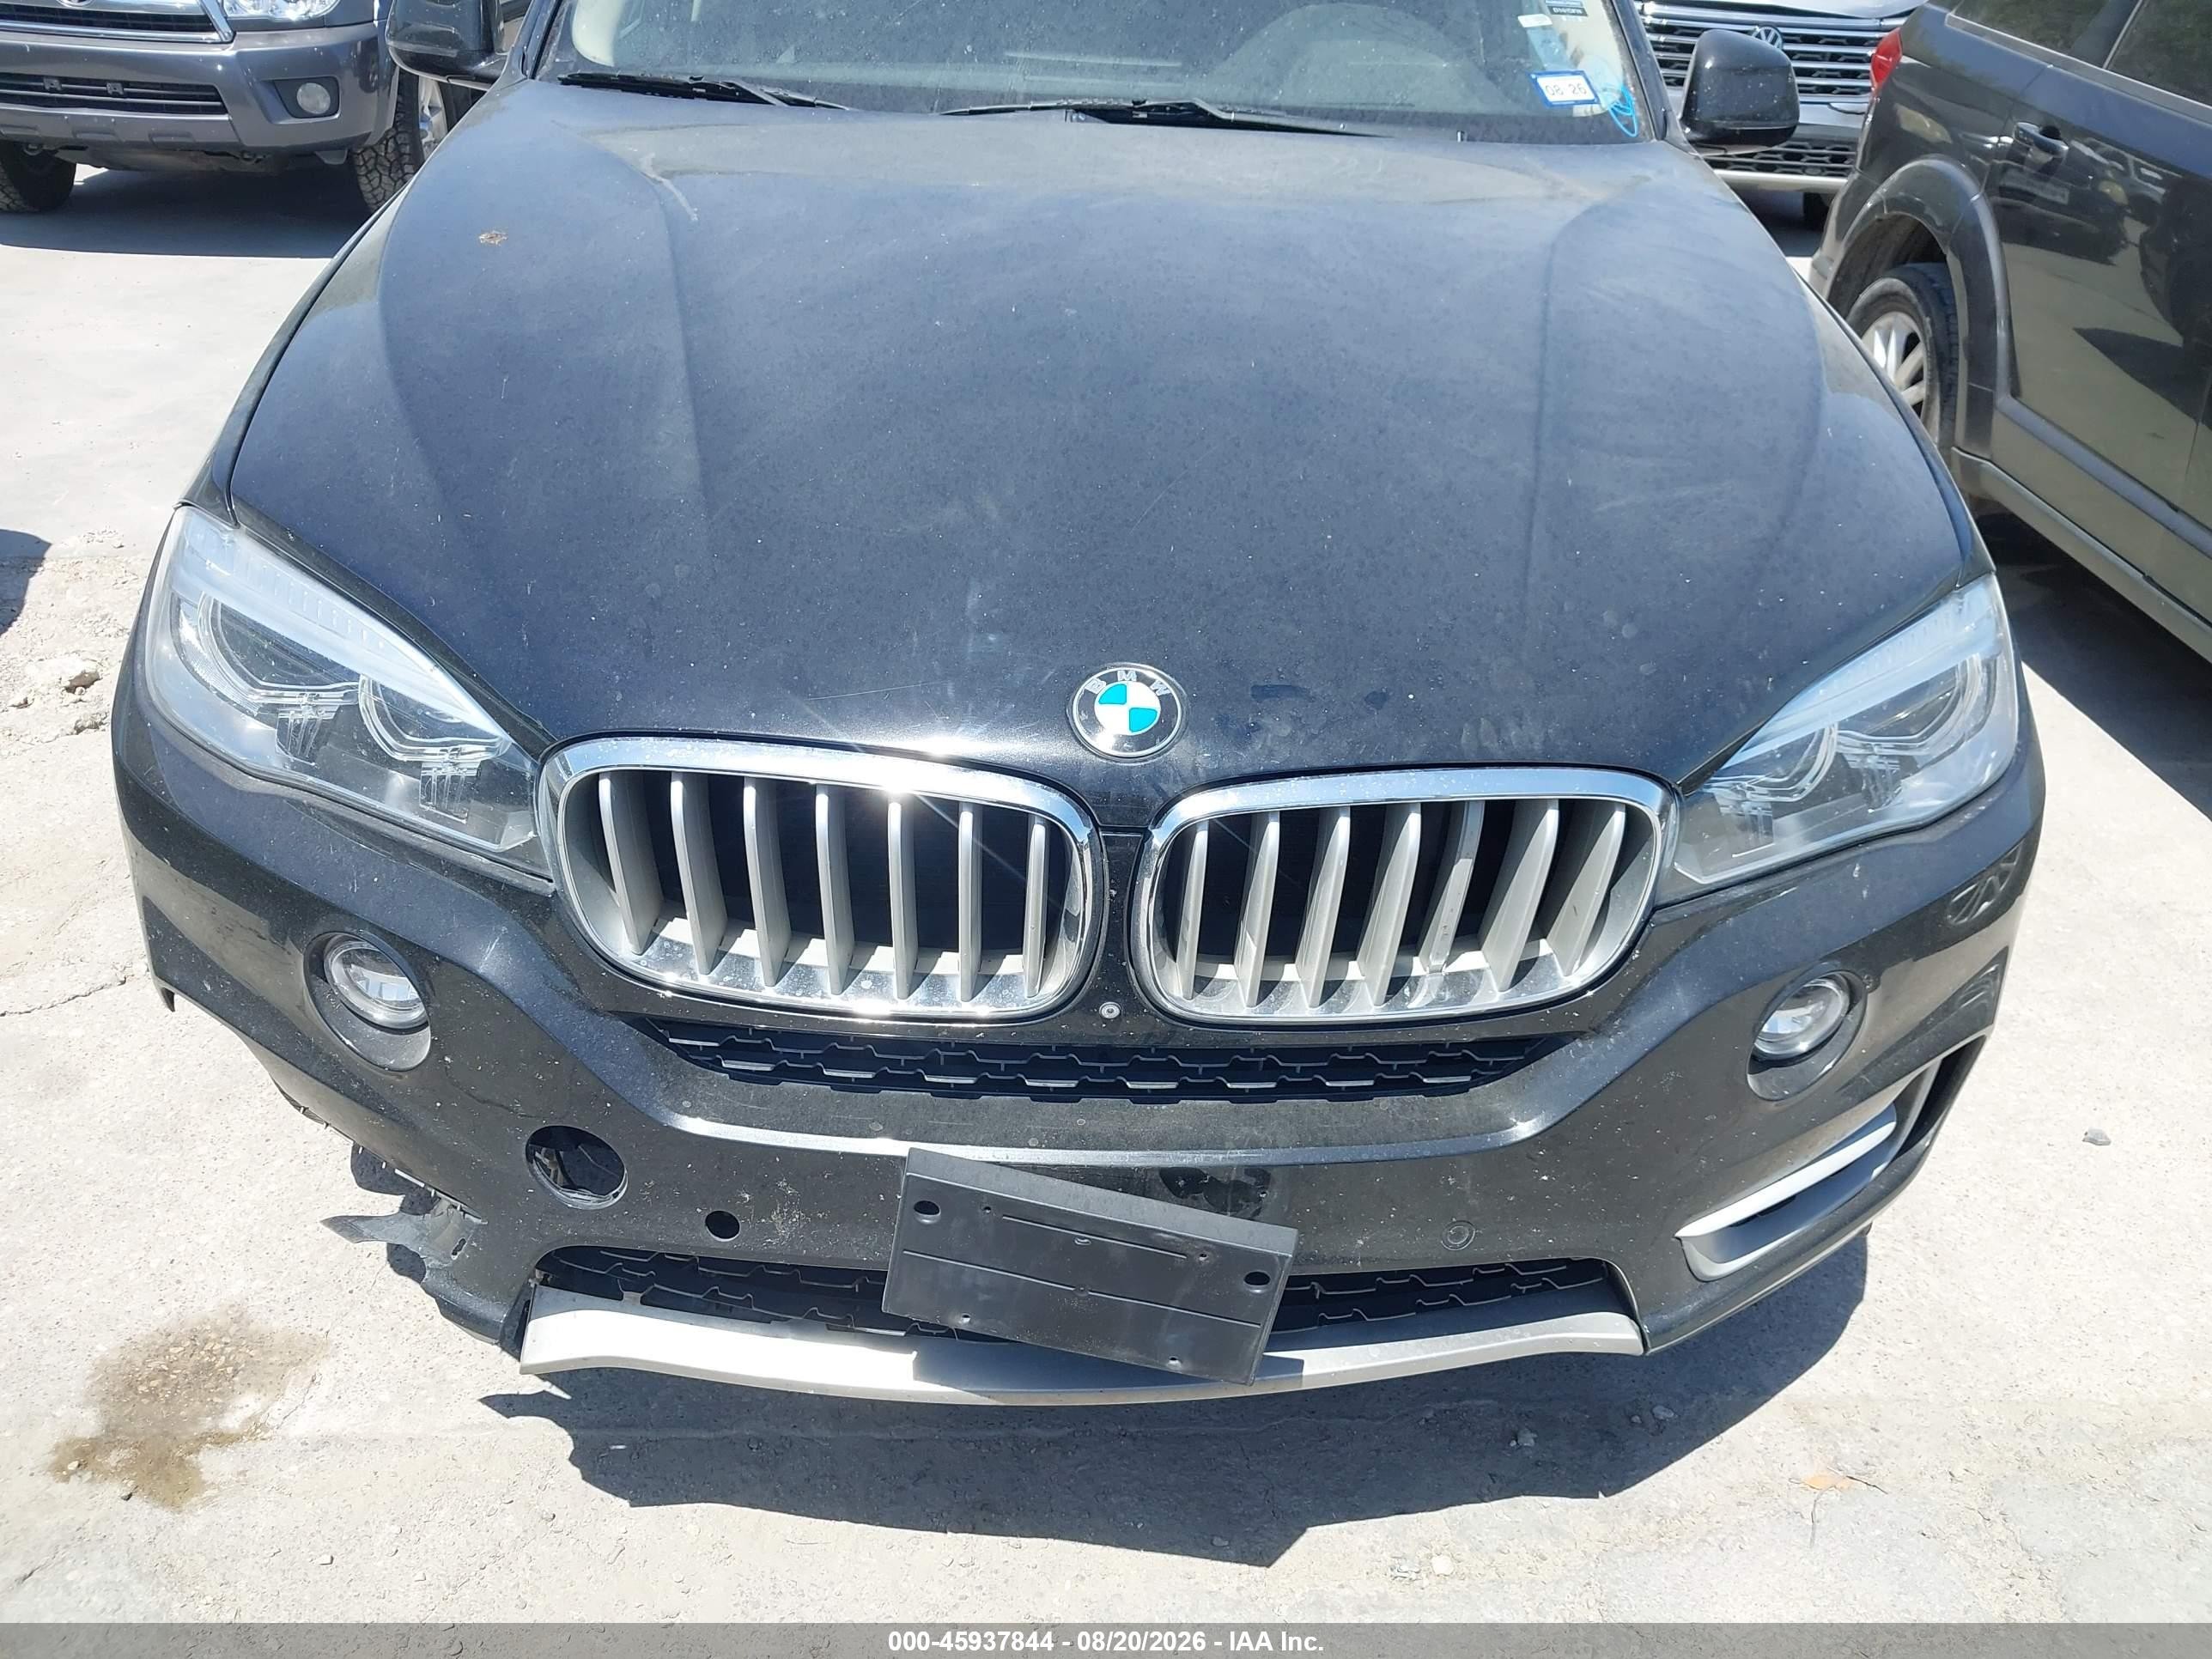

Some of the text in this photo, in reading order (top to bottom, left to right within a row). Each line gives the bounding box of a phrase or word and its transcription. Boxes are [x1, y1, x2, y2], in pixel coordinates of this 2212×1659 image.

[1545, 82, 1588, 97] 08 26
[1085, 670, 1171, 696] BMW
